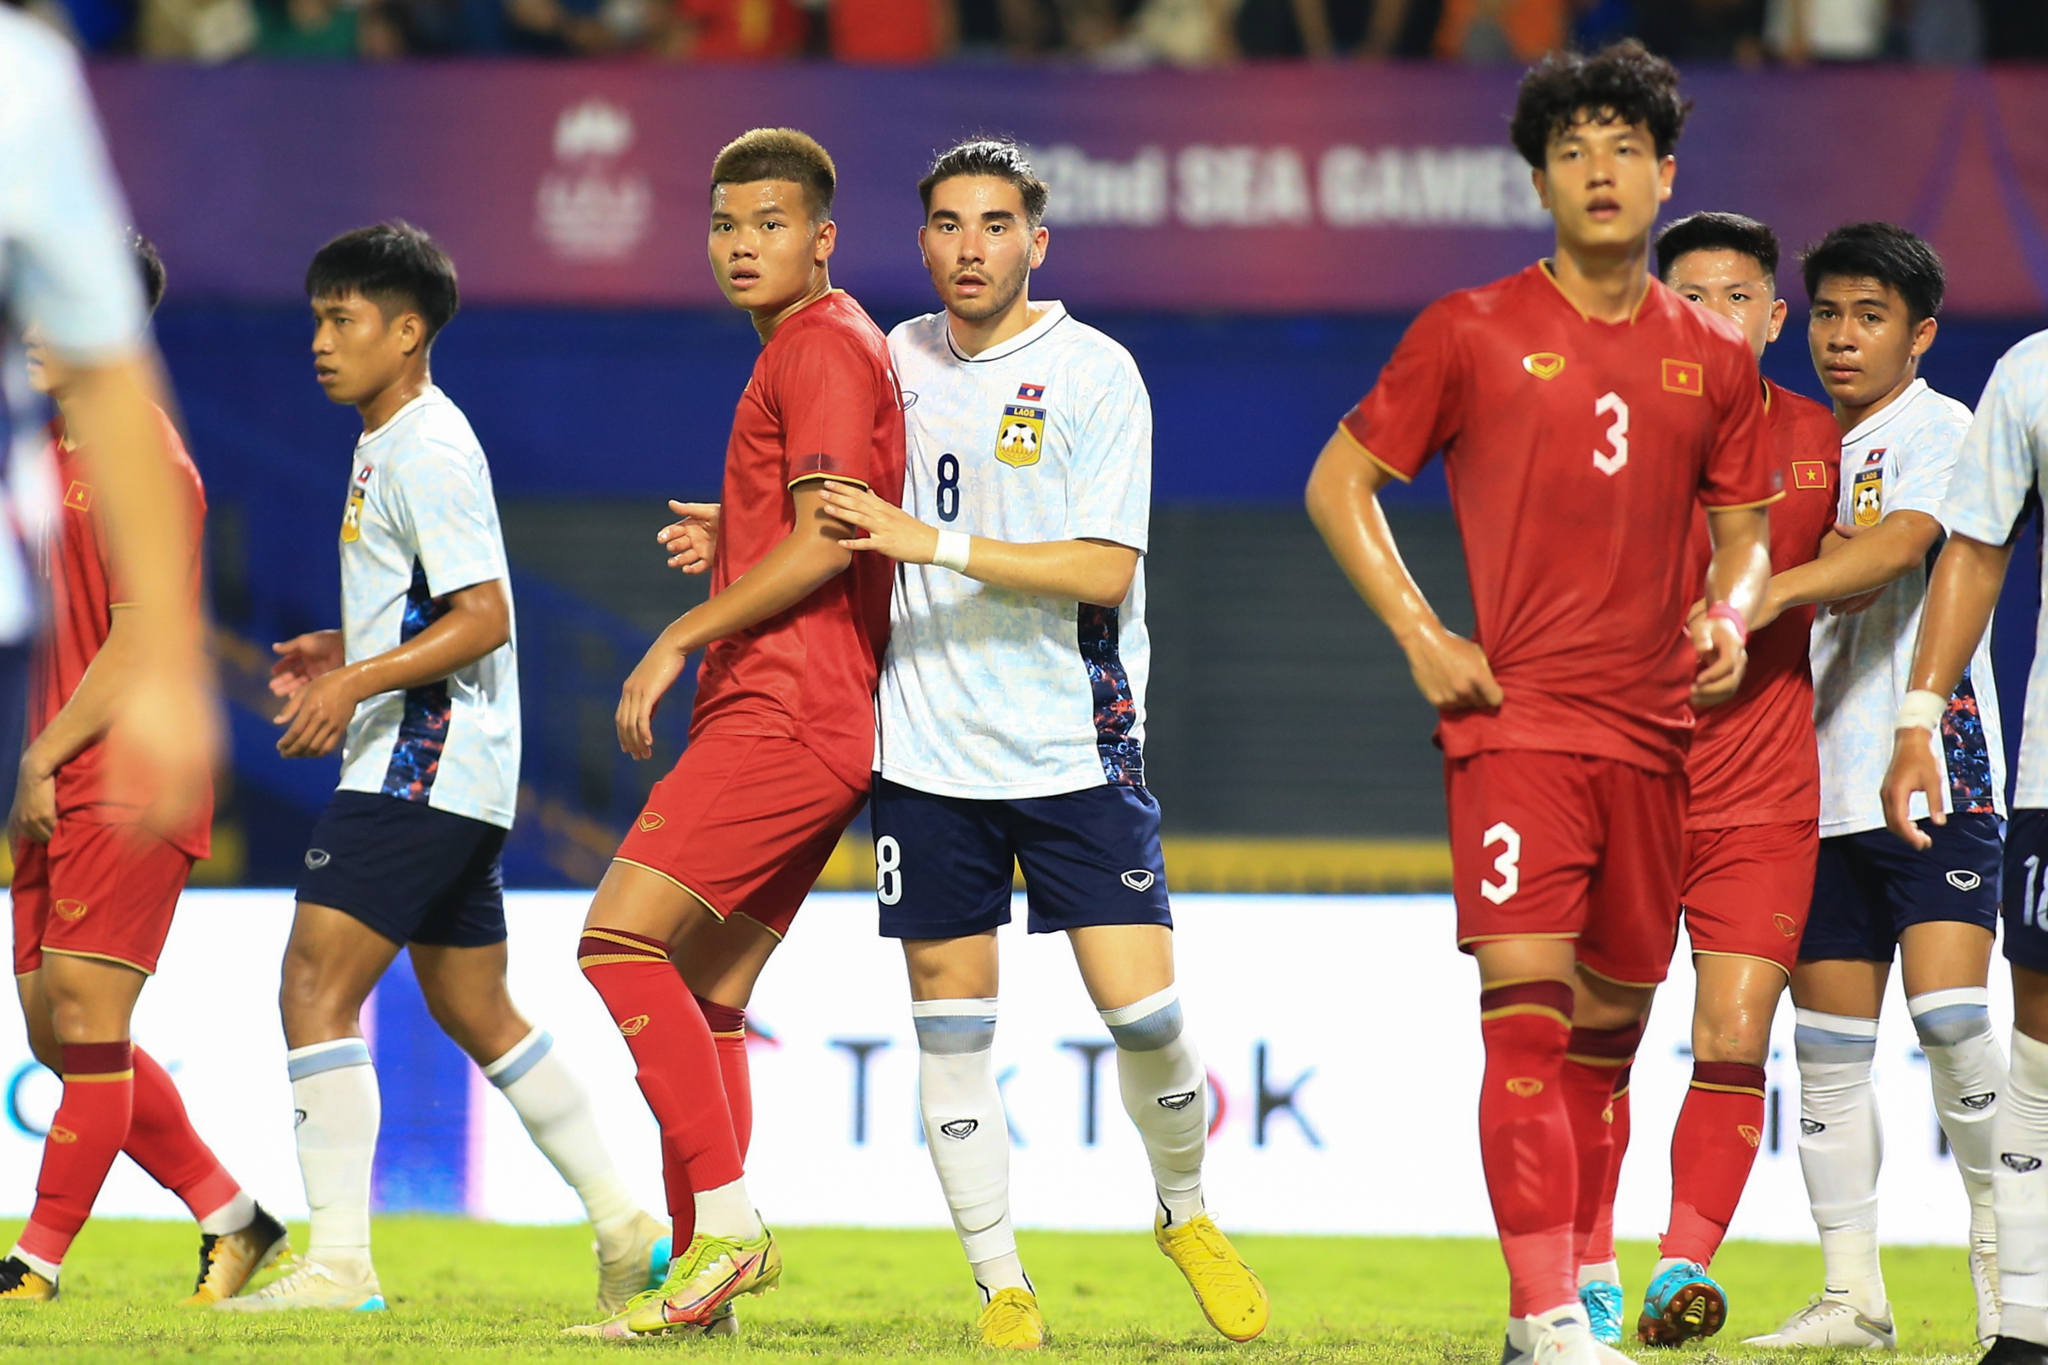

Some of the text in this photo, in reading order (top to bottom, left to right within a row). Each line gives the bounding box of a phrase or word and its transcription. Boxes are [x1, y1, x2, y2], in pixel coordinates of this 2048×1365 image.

[1030, 146, 1167, 225] 2nd
[1176, 147, 1308, 227] SEA
[1013, 407, 1036, 418] LAOS
[1593, 391, 1629, 476] 3
[937, 453, 960, 522] 8
[876, 835, 903, 906] 8
[1480, 821, 1521, 906] 3
